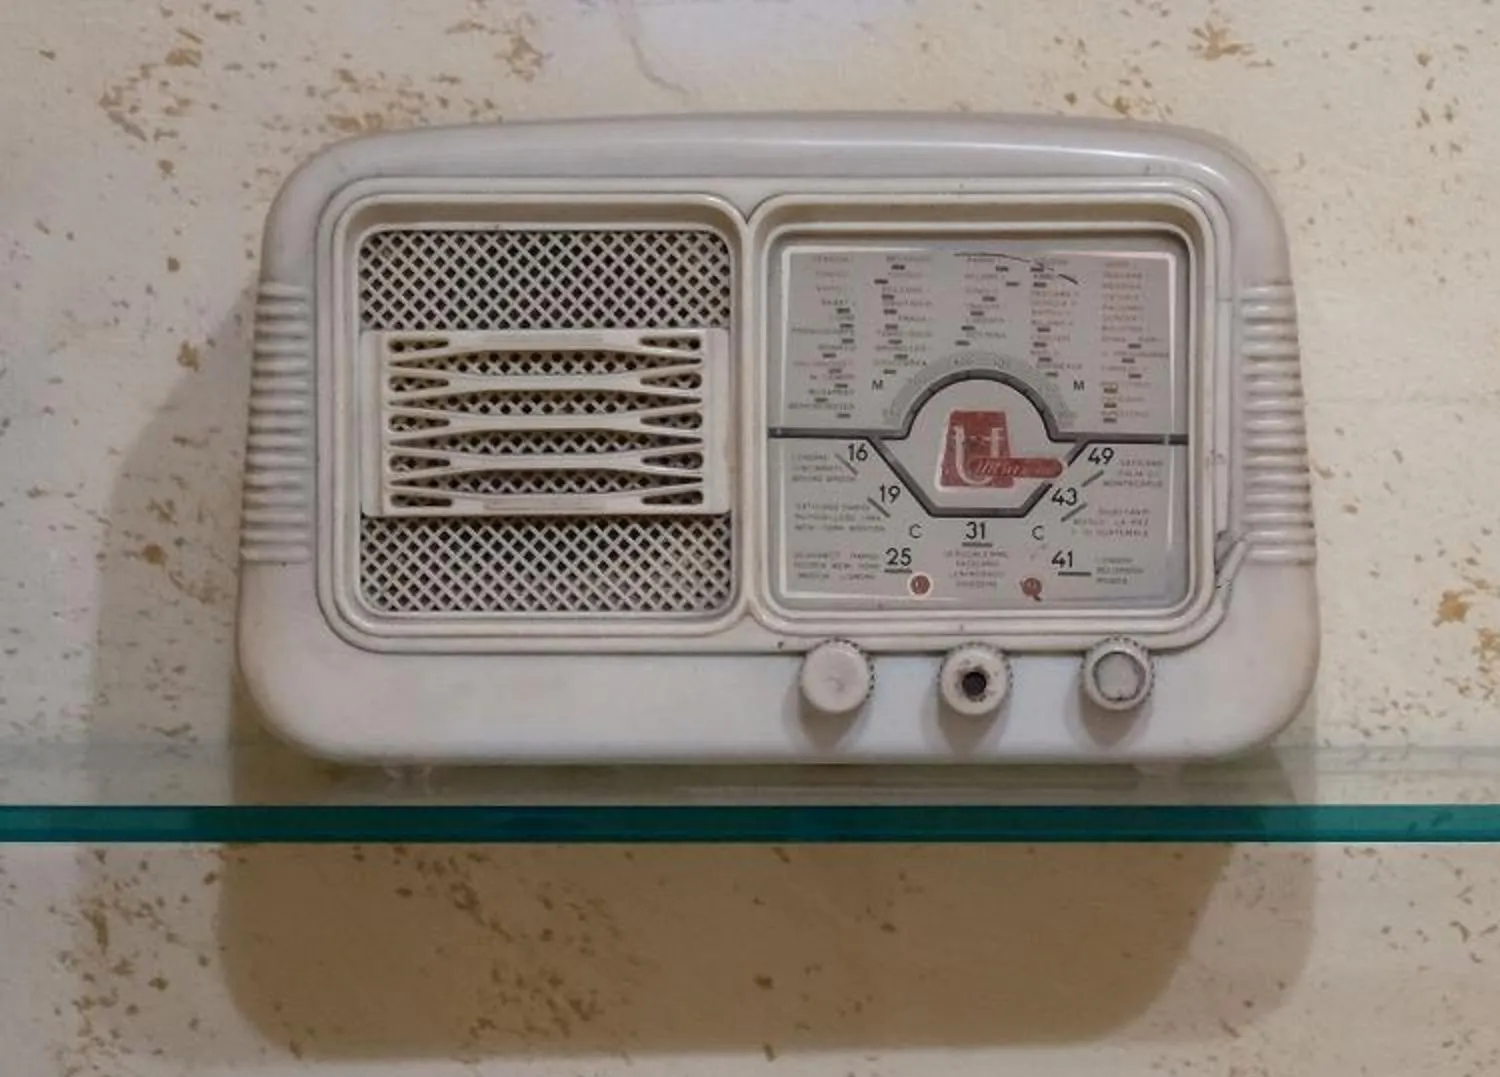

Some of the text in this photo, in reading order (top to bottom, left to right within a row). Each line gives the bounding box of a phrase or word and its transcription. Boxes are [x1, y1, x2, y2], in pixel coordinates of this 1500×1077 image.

[872, 379, 884, 391] M
[1073, 379, 1085, 391] M
[848, 443, 869, 462] 16
[1088, 447, 1115, 466] 49
[879, 485, 901, 505] 19
[1051, 487, 1078, 507] 43
[909, 523, 922, 540] C
[965, 521, 987, 541] 31
[1032, 525, 1045, 541] C
[885, 547, 912, 567] 25
[1051, 550, 1074, 569] 41
